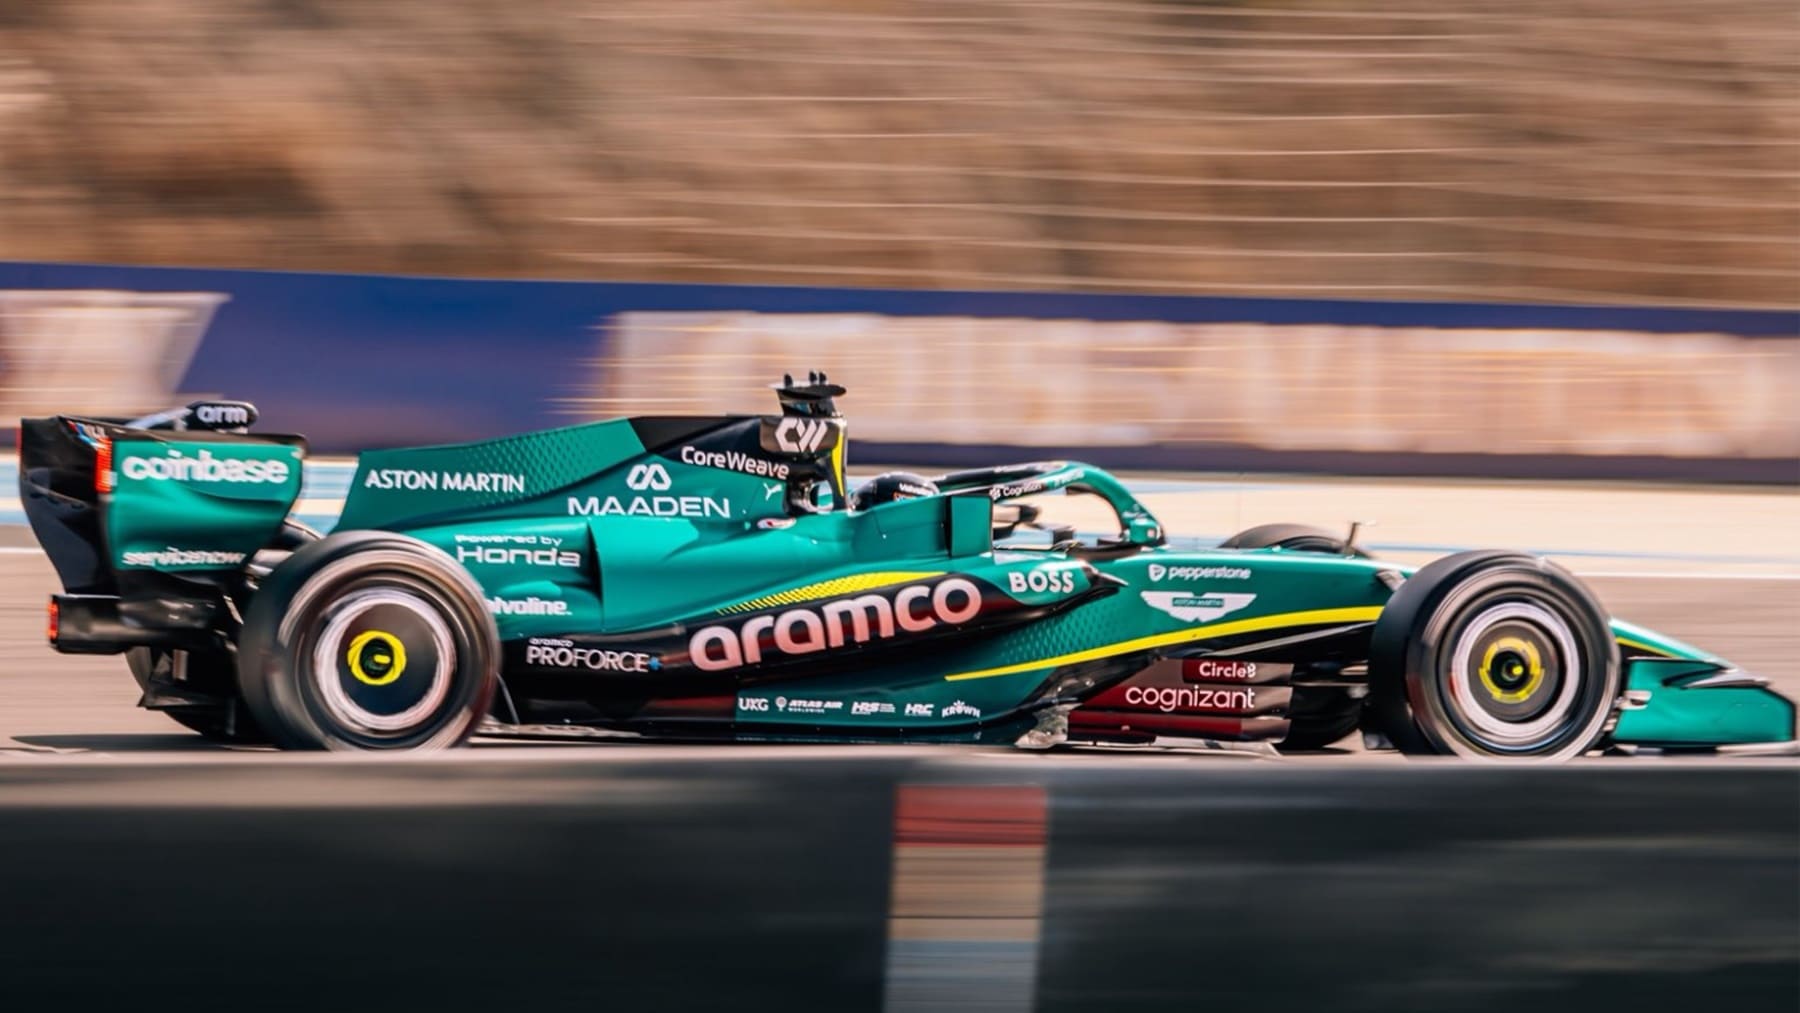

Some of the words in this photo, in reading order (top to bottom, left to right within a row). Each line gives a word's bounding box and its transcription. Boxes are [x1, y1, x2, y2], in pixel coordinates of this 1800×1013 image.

[197, 405, 248, 423] arm
[122, 449, 289, 484] coinbase
[681, 446, 790, 480] CoreWeave
[364, 469, 437, 490] ASTON
[442, 471, 525, 493] MARTIN
[568, 496, 731, 518] MAADEN
[540, 536, 562, 547] by
[122, 546, 247, 566] servicenow
[457, 546, 581, 567] Honda
[1008, 569, 1074, 593] BOSS
[1168, 566, 1252, 580] pepperstone
[688, 578, 982, 671] aramco
[529, 637, 574, 648] aramco
[738, 697, 769, 711] UKG
[789, 700, 823, 708] ATLAS
[823, 701, 843, 709] AIR
[852, 701, 880, 713] HRS
[1125, 685, 1255, 712] cognizant
[905, 703, 934, 715] HRC
